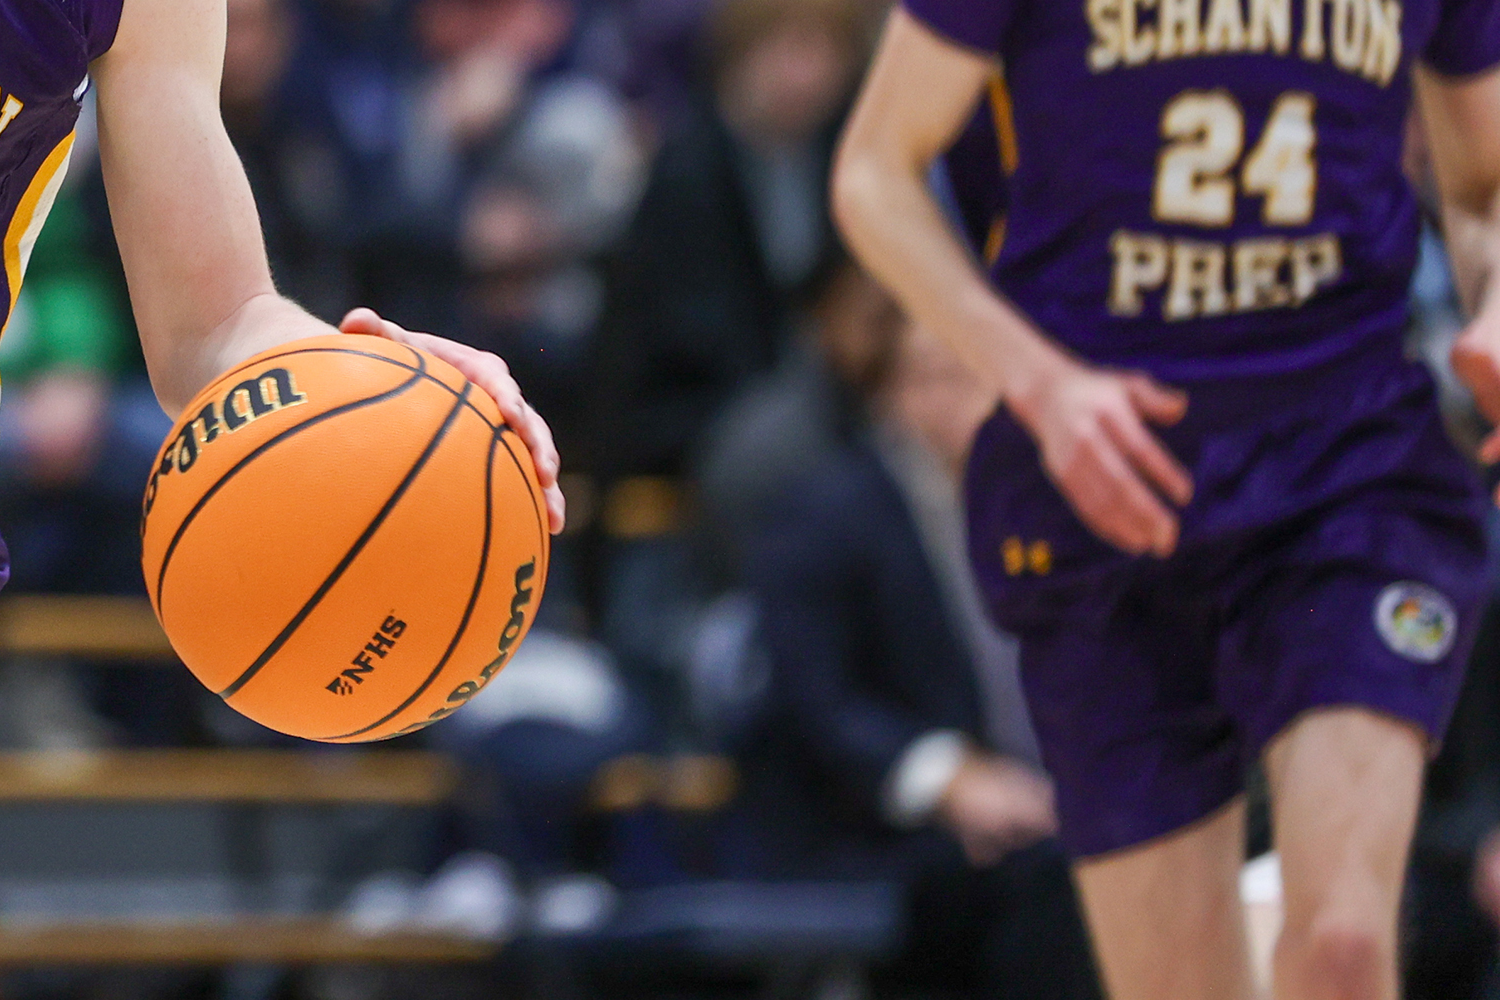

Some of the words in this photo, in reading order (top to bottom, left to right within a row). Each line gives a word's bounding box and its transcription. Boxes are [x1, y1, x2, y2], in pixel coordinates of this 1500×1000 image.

[1151, 88, 1317, 227] 24
[1107, 230, 1342, 322] PREP
[140, 367, 308, 538] Wilso
[341, 615, 407, 685] NFHS
[378, 555, 536, 737] lson
